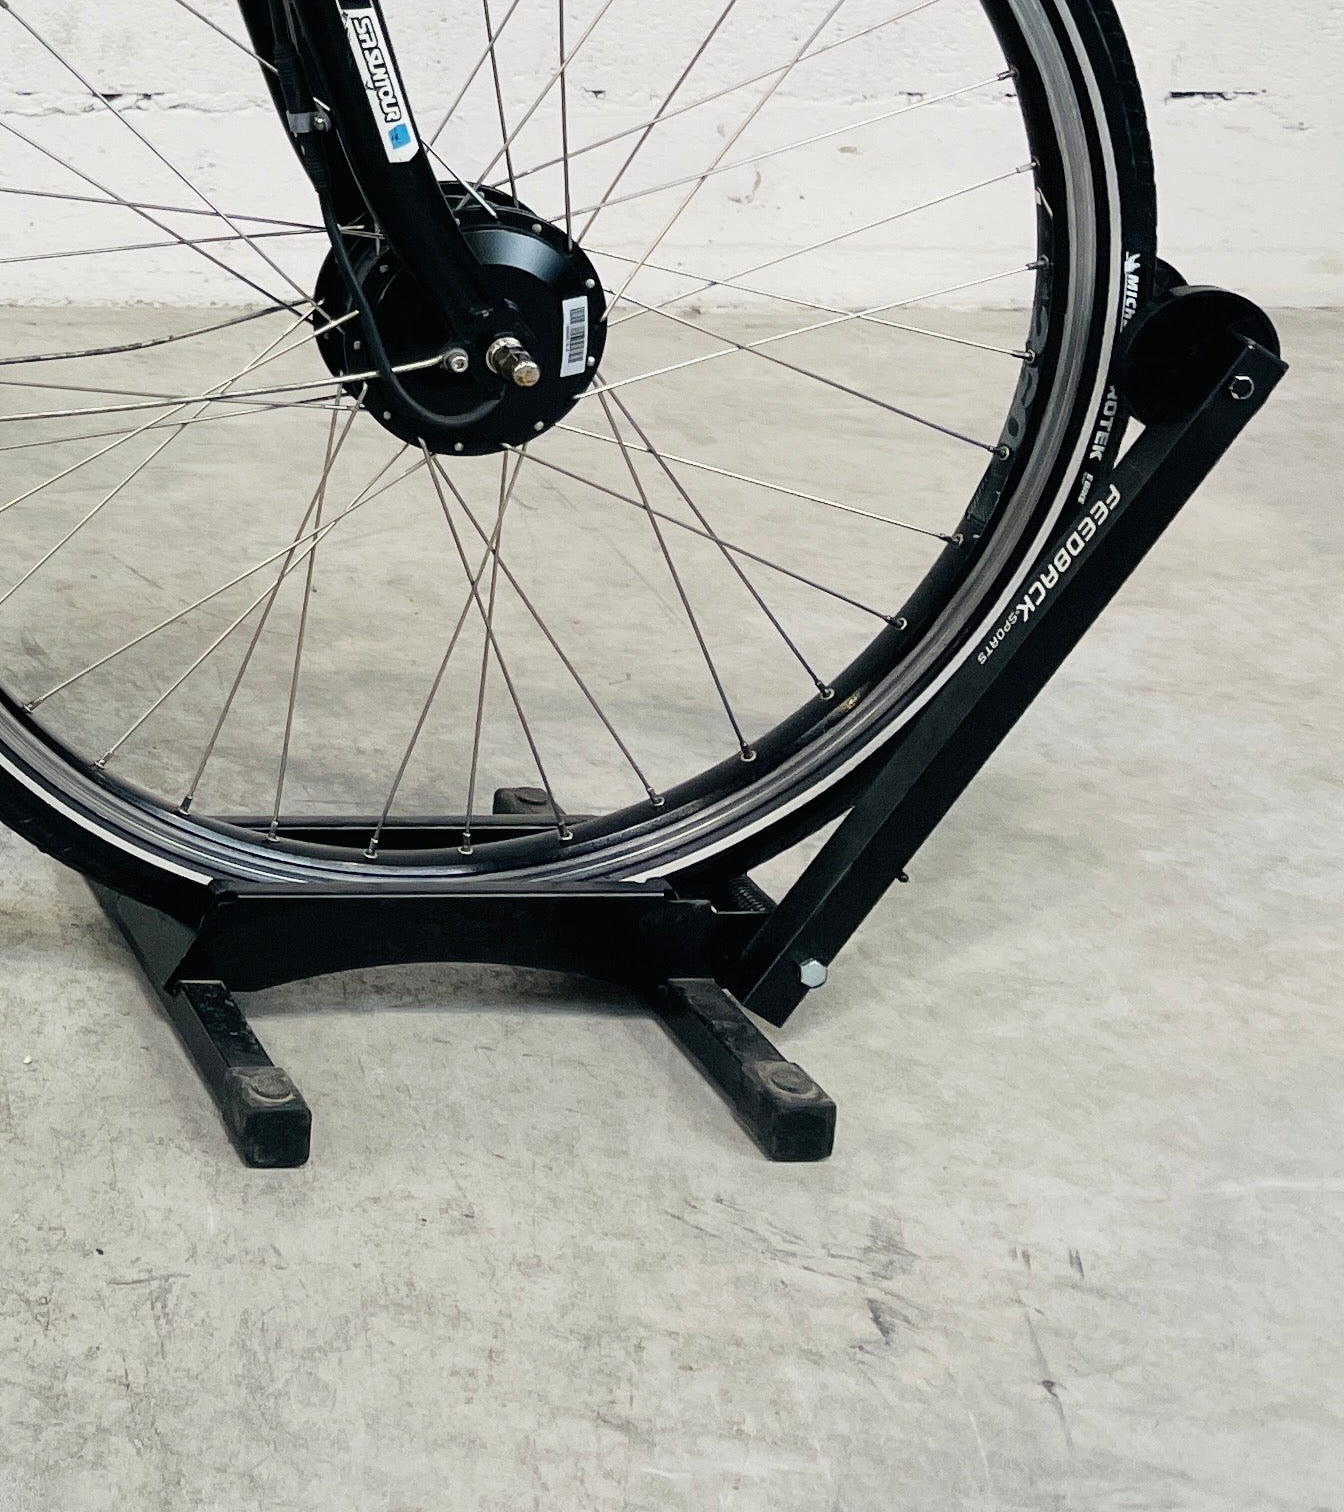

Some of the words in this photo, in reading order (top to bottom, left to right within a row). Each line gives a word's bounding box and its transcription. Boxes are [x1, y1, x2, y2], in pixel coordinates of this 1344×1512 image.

[363, 48, 402, 123] SUNTOUR
[1015, 484, 1120, 623] FEEDBACK
[977, 613, 1019, 665] SPORTS
